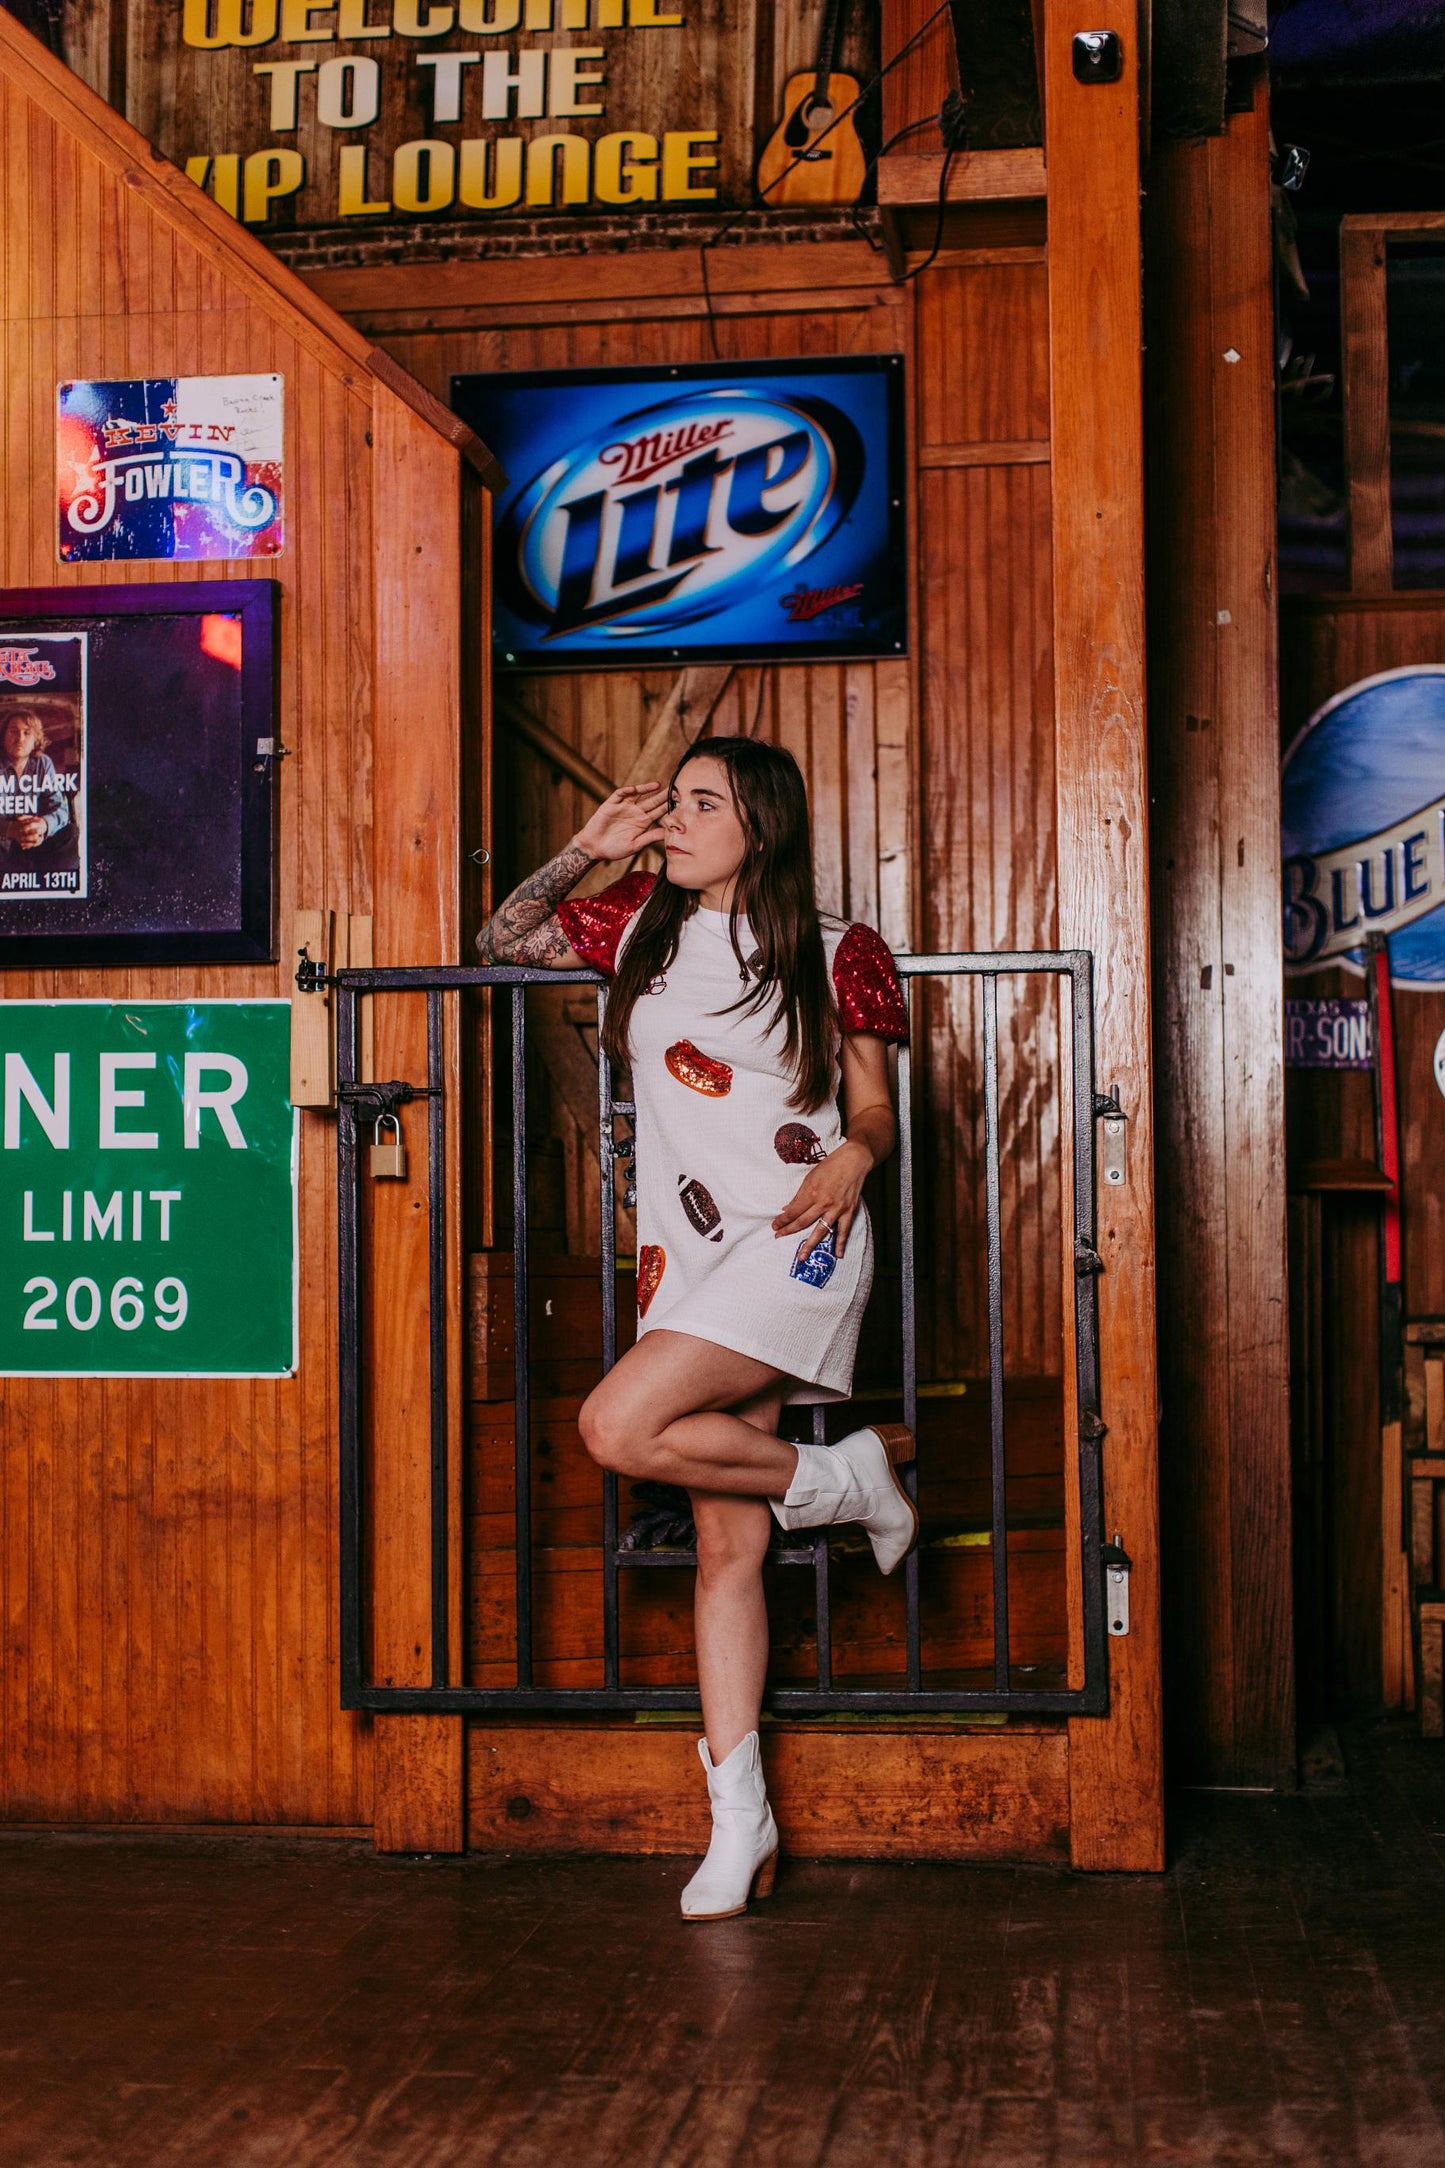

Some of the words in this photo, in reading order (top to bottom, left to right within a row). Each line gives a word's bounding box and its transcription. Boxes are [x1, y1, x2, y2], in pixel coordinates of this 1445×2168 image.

[252, 55, 380, 133] TO
[416, 46, 606, 123] THE
[338, 129, 720, 217] LOUNGE
[104, 421, 236, 448] KEVIN
[599, 418, 734, 486] Miller
[67, 449, 277, 534] FOWLER
[779, 583, 865, 621] Miller
[18, 772, 78, 793] CLARK
[1, 871, 40, 890] APRIL
[43, 870, 77, 889] 13TH
[1283, 831, 1431, 965] BLUE
[3, 1052, 249, 1150] NER
[22, 1190, 182, 1242] LIMIT
[22, 1276, 190, 1331] 2069
